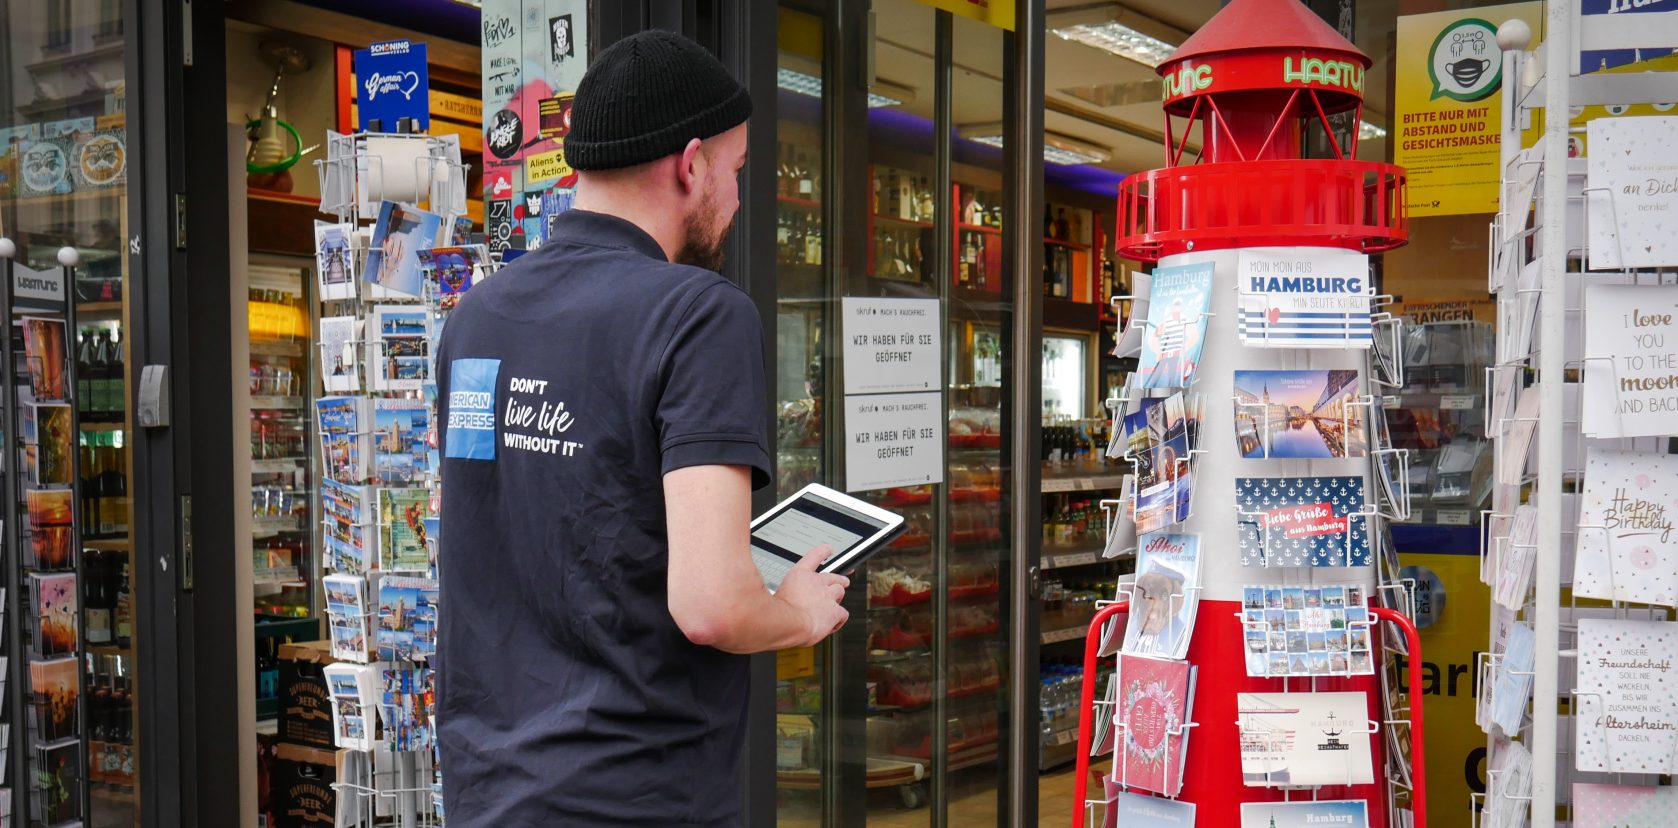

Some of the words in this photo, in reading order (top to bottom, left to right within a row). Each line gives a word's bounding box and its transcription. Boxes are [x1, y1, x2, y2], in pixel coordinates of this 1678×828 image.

[1403, 112, 1437, 124] BITTE
[1439, 109, 1464, 121] NUR
[1467, 107, 1489, 119] MIT
[1402, 124, 1457, 137] ABSTAND
[1460, 121, 1486, 133] UND
[1402, 134, 1501, 151] GESICHTSMASKE
[530, 157, 554, 168] Aliens
[532, 171, 541, 179] in
[541, 166, 567, 178] Action
[1623, 184, 1640, 195] an
[1154, 269, 1211, 288] Hamburg
[1250, 277, 1362, 293] HAMBURG
[1633, 308, 1672, 328] love
[853, 335, 868, 346] WIR
[872, 334, 896, 345] HABEN
[900, 332, 915, 345] FÜR
[918, 334, 932, 345] SIE
[1633, 333, 1664, 349] YOU
[875, 350, 912, 362] GEÖFFNET
[1624, 355, 1644, 371] TO
[1647, 354, 1678, 370] THE
[509, 377, 548, 395] DON'T
[1614, 398, 1643, 414] AND
[448, 413, 494, 428] EXPRESS
[504, 397, 537, 428] live
[537, 400, 575, 437] life
[503, 432, 560, 454] WITHOUT
[855, 432, 870, 443] WIR
[874, 430, 898, 443] HABEN
[902, 427, 916, 440] FÜR
[920, 428, 933, 439] SIE
[877, 446, 914, 459] GEÖFFNET
[1611, 487, 1666, 520] Happy
[1264, 512, 1292, 525] Liebe
[1293, 507, 1328, 523] Grüße
[1602, 508, 1675, 543] Birthday
[1145, 536, 1186, 554] Ahoi
[1620, 648, 1649, 656] UNSERE
[1598, 658, 1671, 672] Freundschaft
[1595, 714, 1676, 731] Altersheim
[1305, 813, 1353, 824] Hamburg
